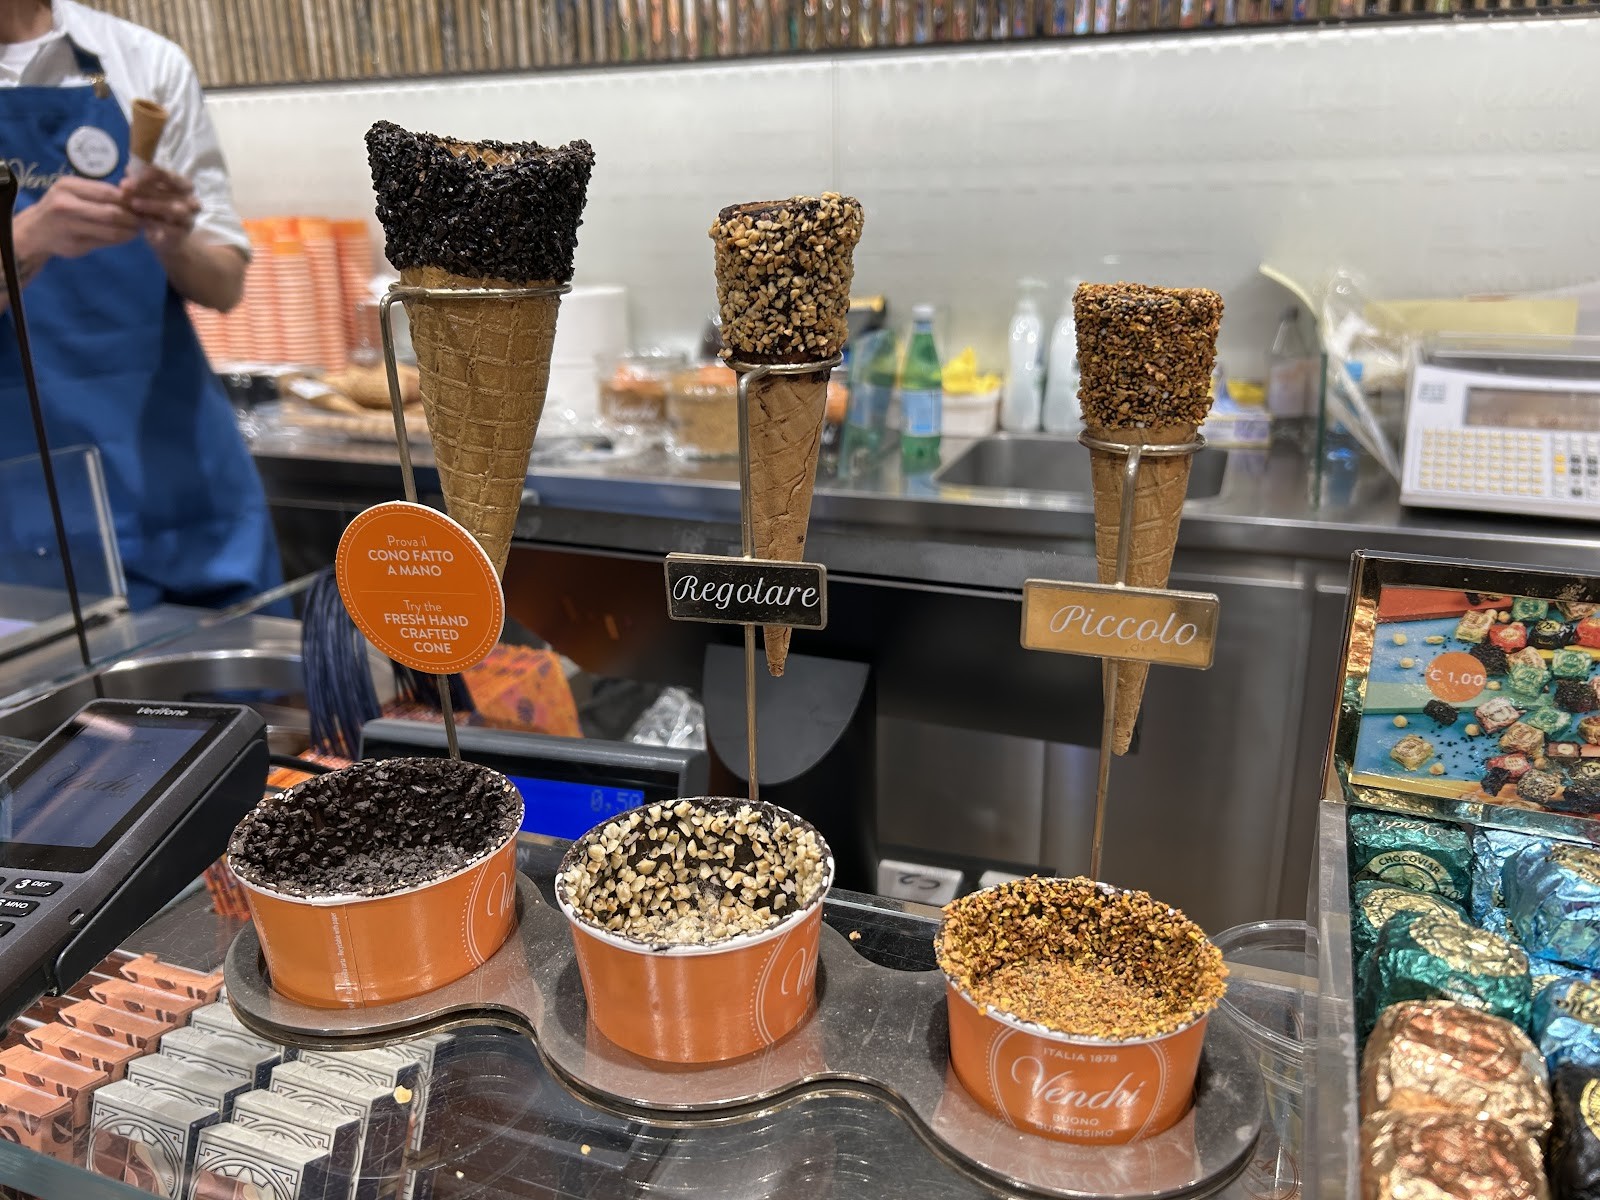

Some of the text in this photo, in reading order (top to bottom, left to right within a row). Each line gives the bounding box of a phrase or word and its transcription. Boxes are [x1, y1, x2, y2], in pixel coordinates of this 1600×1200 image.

[387, 535, 428, 547] Prova il
[368, 549, 454, 562] CONO FATTO
[388, 565, 442, 577] A MANO
[672, 575, 820, 610] Regolare
[403, 599, 442, 614] Try the
[384, 613, 469, 627] FRESH HAND
[1049, 604, 1198, 646] Piccolo
[400, 627, 459, 641] CRAFTED
[414, 641, 453, 654] CONE
[1430, 669, 1484, 686] € 1,00
[136, 706, 189, 717] Verifone
[1378, 854, 1440, 875] CHOCOVIAR
[15, 879, 52, 889] 3 DEF
[4, 900, 29, 909] MNO
[1043, 1046, 1118, 1063] ITALIA 1878
[1010, 1055, 1148, 1110] Venchi
[1052, 1113, 1100, 1126] BUONO
[1035, 1120, 1115, 1138] BUONISSIMO
